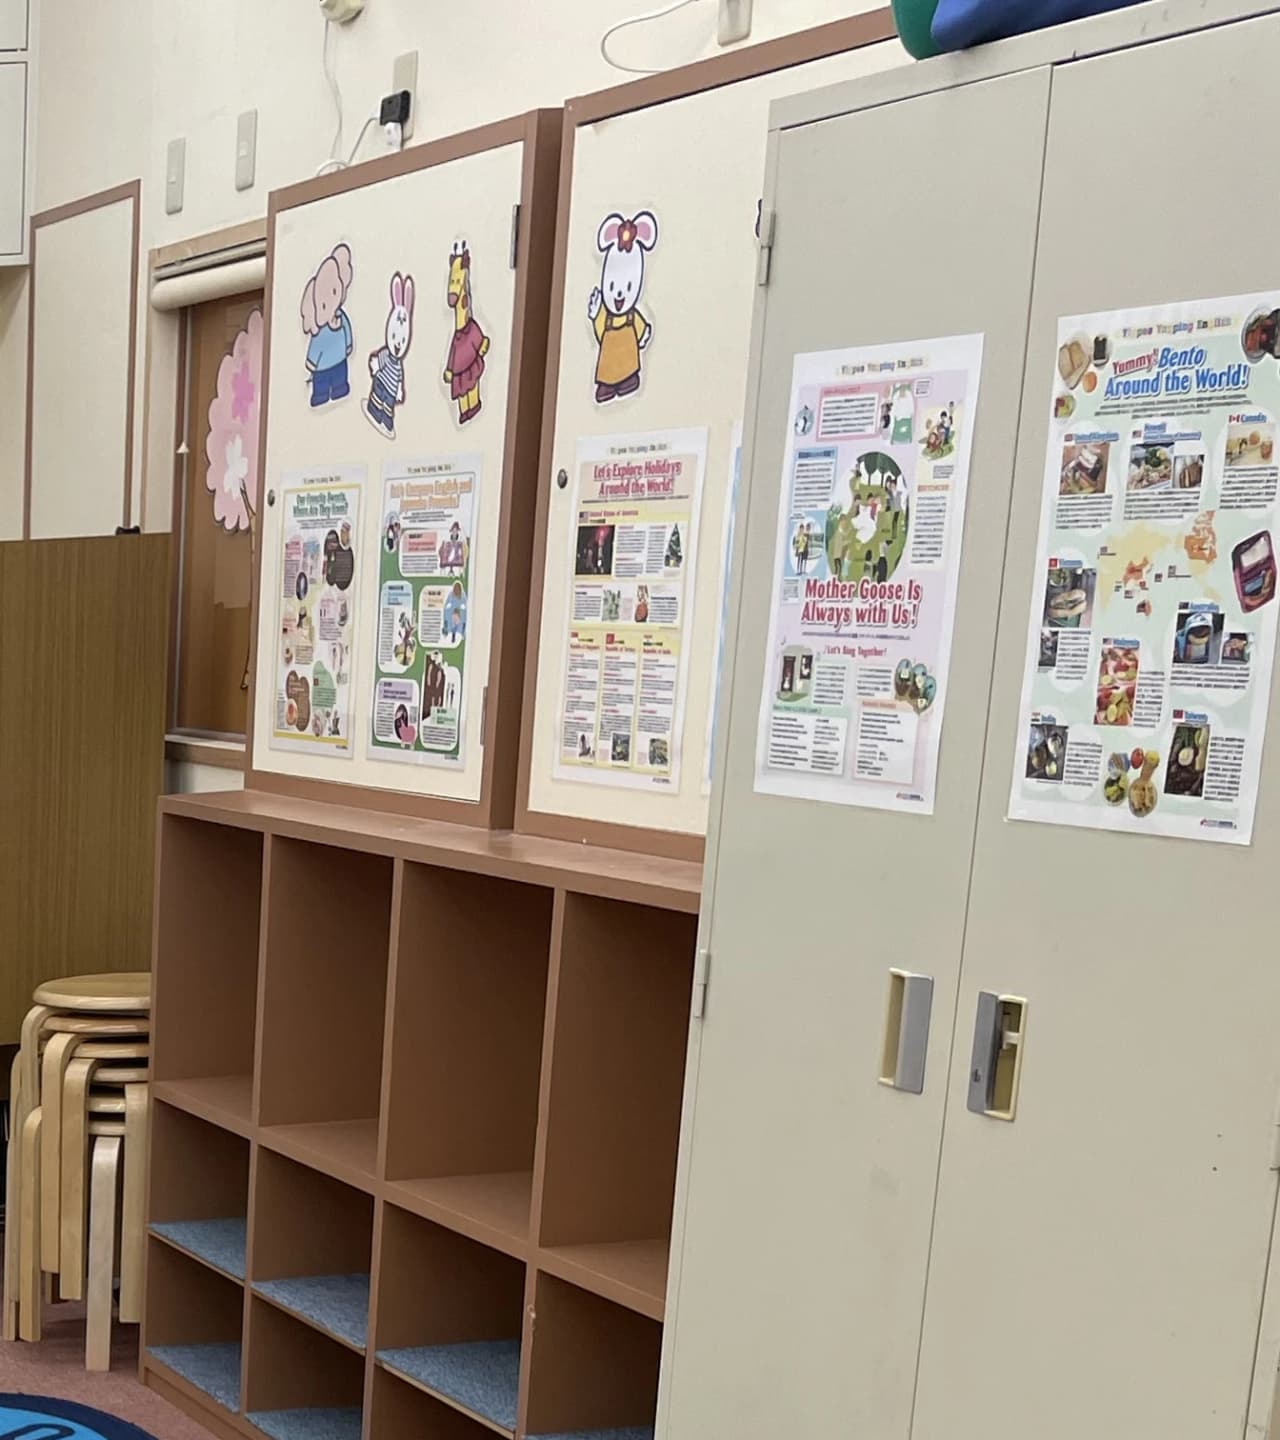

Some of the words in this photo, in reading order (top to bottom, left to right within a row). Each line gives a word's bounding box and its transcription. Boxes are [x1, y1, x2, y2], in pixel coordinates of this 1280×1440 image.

[1158, 346, 1205, 368] Bento
[1104, 373, 1160, 398] Around
[1165, 371, 1189, 393] the
[1196, 364, 1249, 388] World!
[645, 459, 681, 477] Holidays
[805, 578, 855, 600] Mother
[859, 579, 902, 601] Goose
[906, 579, 922, 601] Is
[801, 602, 851, 628] Always
[856, 604, 887, 625] with
[892, 603, 918, 626] Us!
